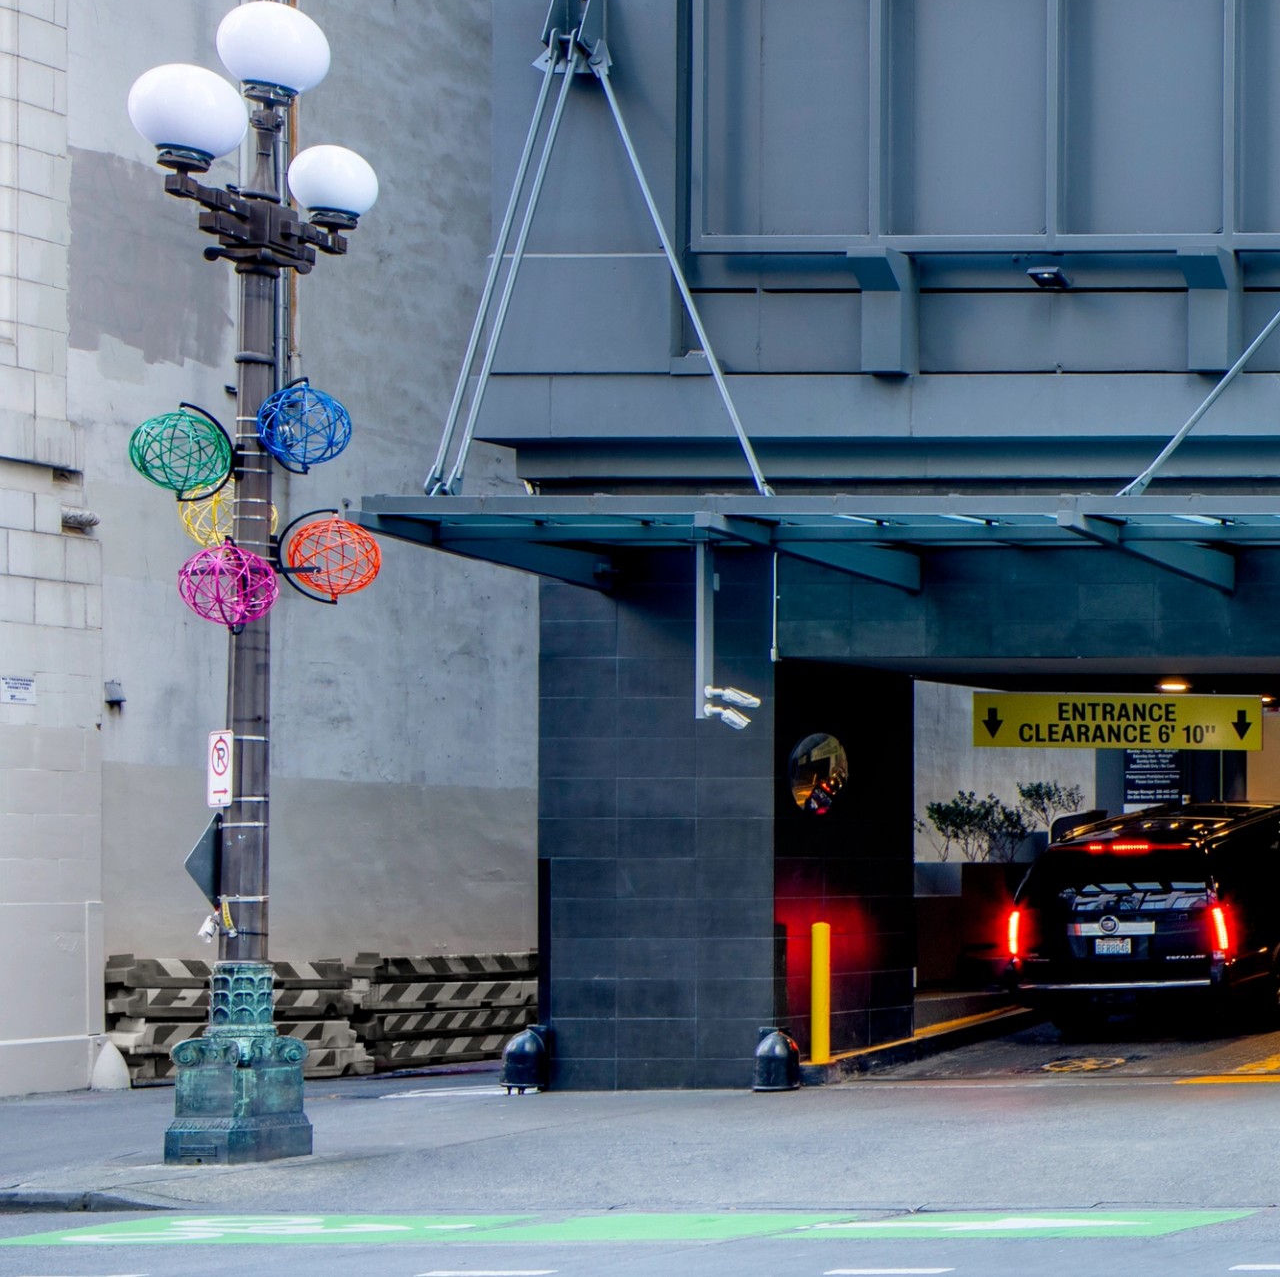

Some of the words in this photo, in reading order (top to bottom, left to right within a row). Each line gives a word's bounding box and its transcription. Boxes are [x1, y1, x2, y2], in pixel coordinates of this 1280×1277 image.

[1057, 702, 1177, 722] ENTRANCE
[1018, 723, 1151, 743] CLEARANCE
[1158, 725, 1175, 743] 6'
